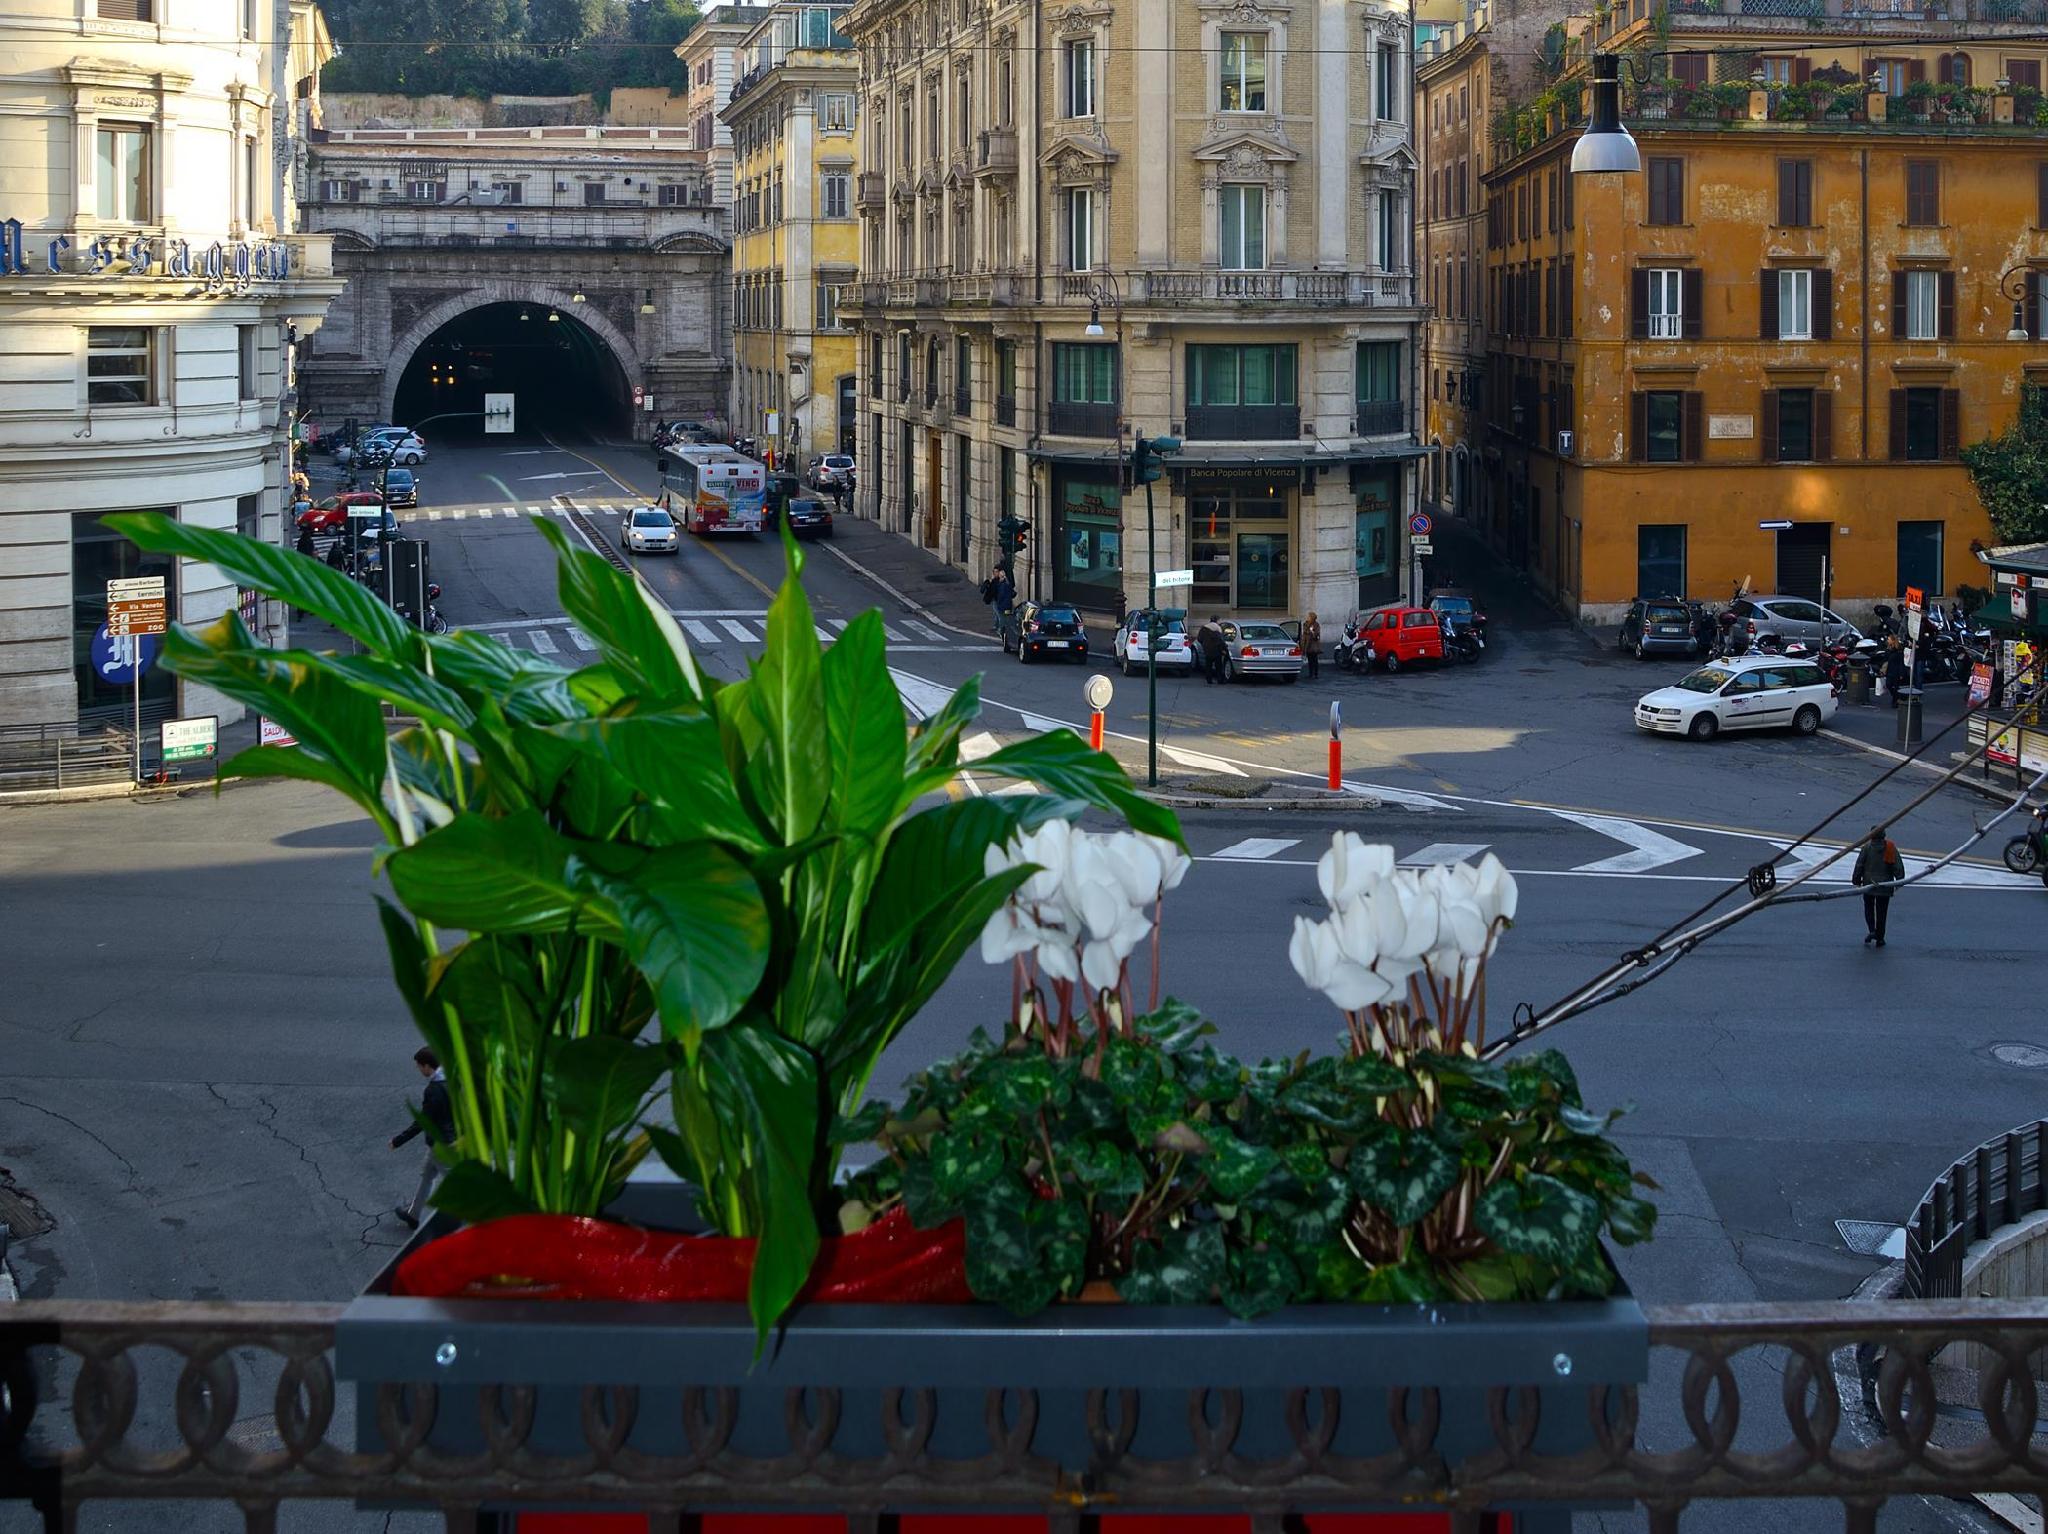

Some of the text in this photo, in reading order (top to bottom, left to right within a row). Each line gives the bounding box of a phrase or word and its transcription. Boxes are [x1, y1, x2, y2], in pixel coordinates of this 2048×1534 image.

[1190, 467, 1296, 478] Banca Popolare di Vicenza
